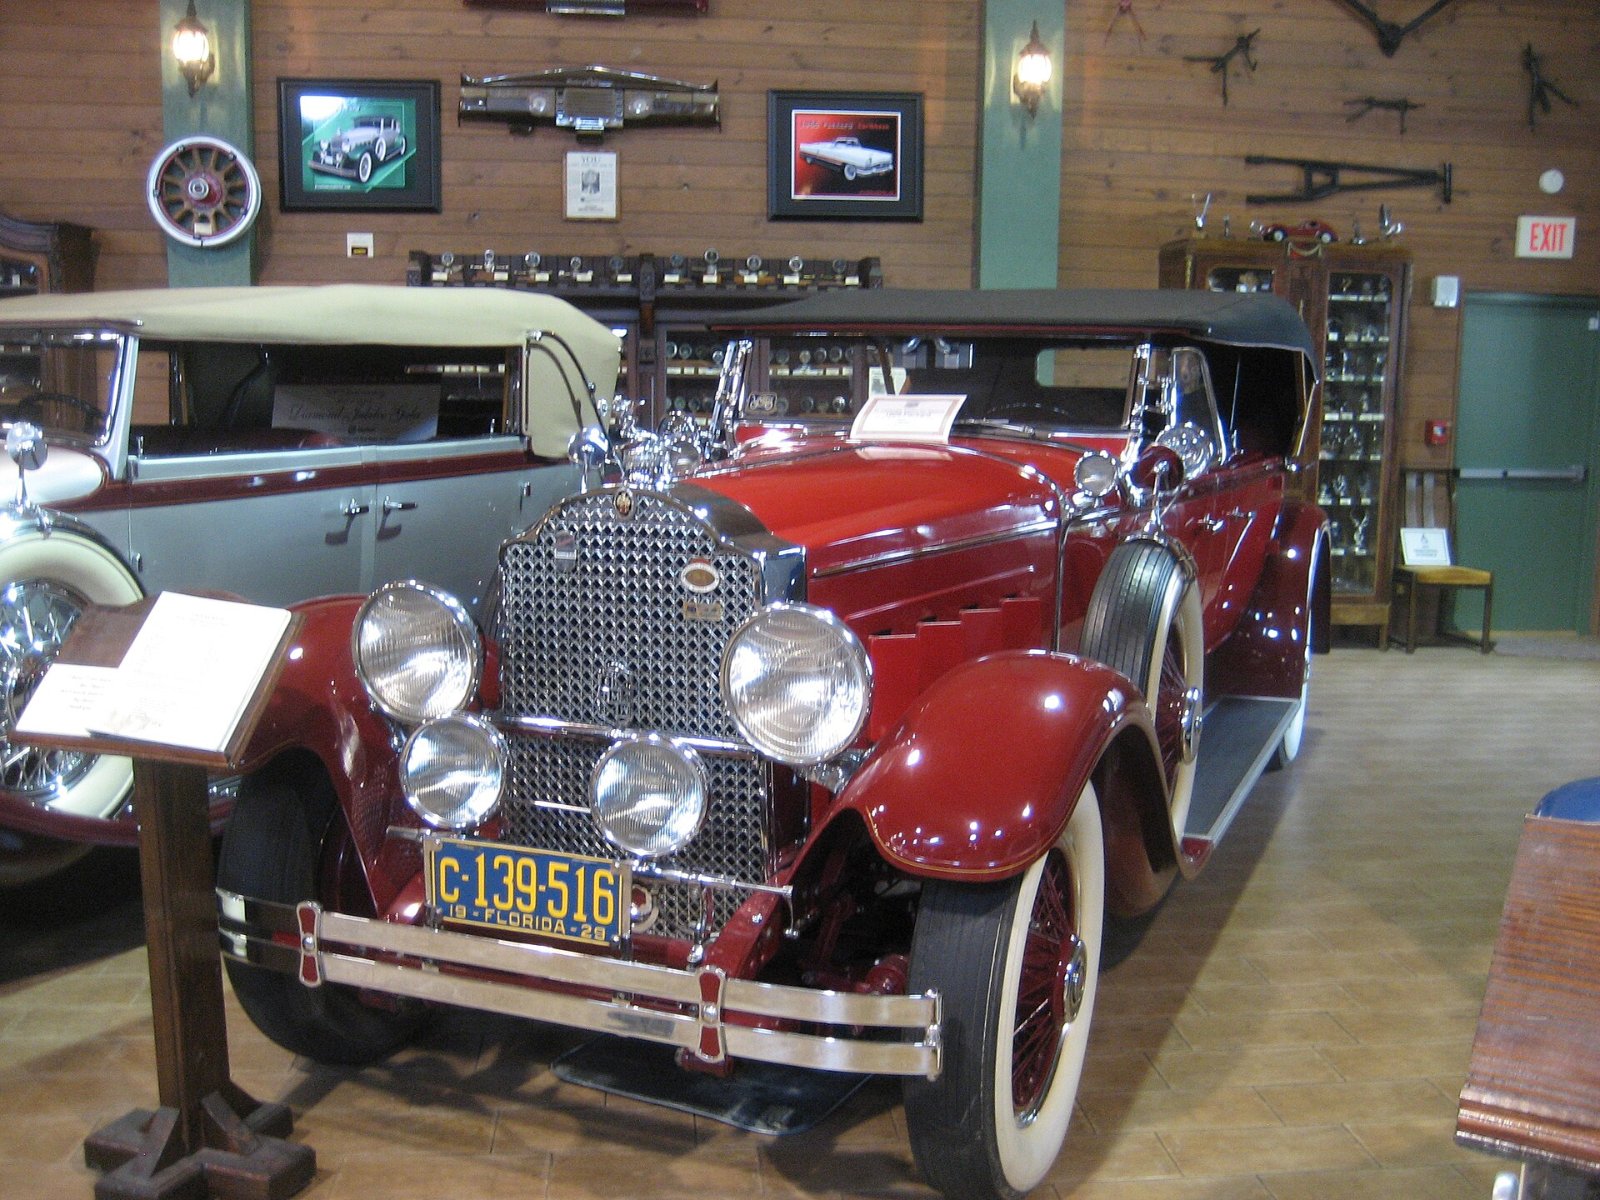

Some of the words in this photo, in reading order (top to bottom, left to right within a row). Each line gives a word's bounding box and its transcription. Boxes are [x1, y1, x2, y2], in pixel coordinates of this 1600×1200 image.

[1529, 223, 1567, 252] EXIT
[439, 852, 615, 925] C-139-516
[450, 904, 467, 918] 19
[484, 907, 566, 934] FLORIDA
